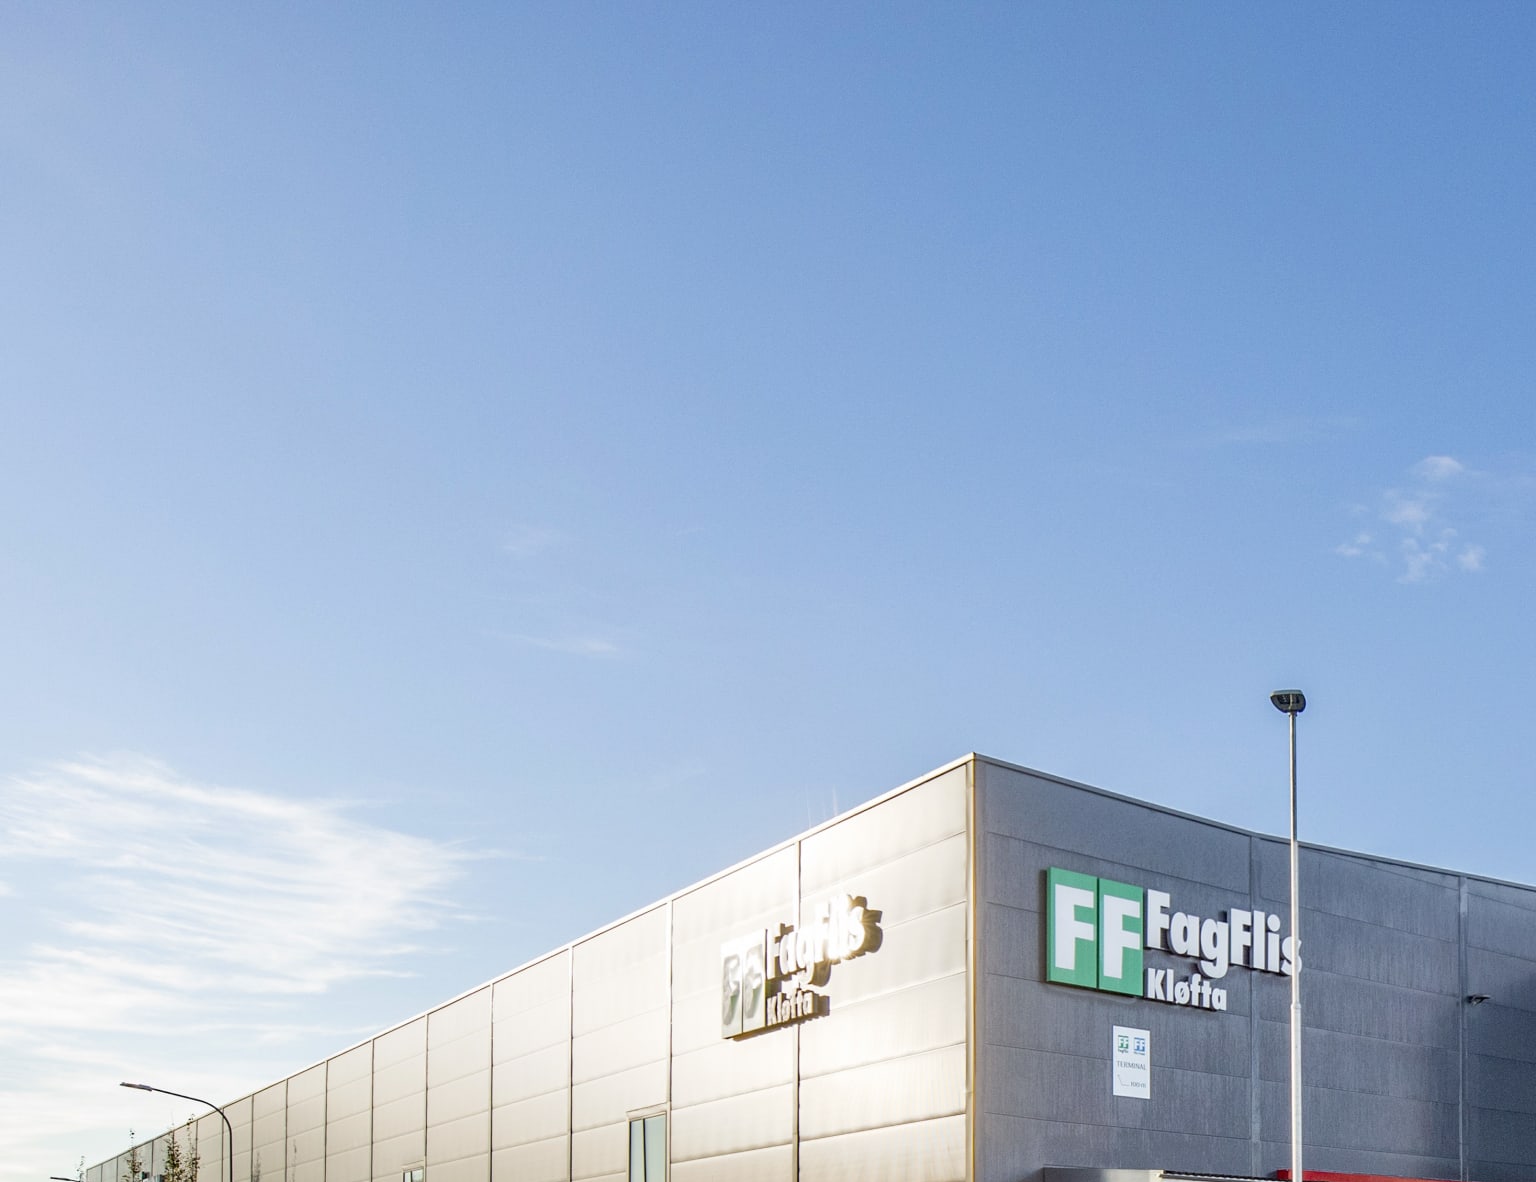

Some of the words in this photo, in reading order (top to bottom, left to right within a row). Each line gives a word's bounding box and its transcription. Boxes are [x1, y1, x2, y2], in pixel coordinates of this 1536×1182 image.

[1055, 884, 1140, 979] FF
[1147, 889, 1302, 978] FagFlis
[1147, 968, 1227, 1011] Kløfta
[1116, 1061, 1146, 1071] TERMINAL
